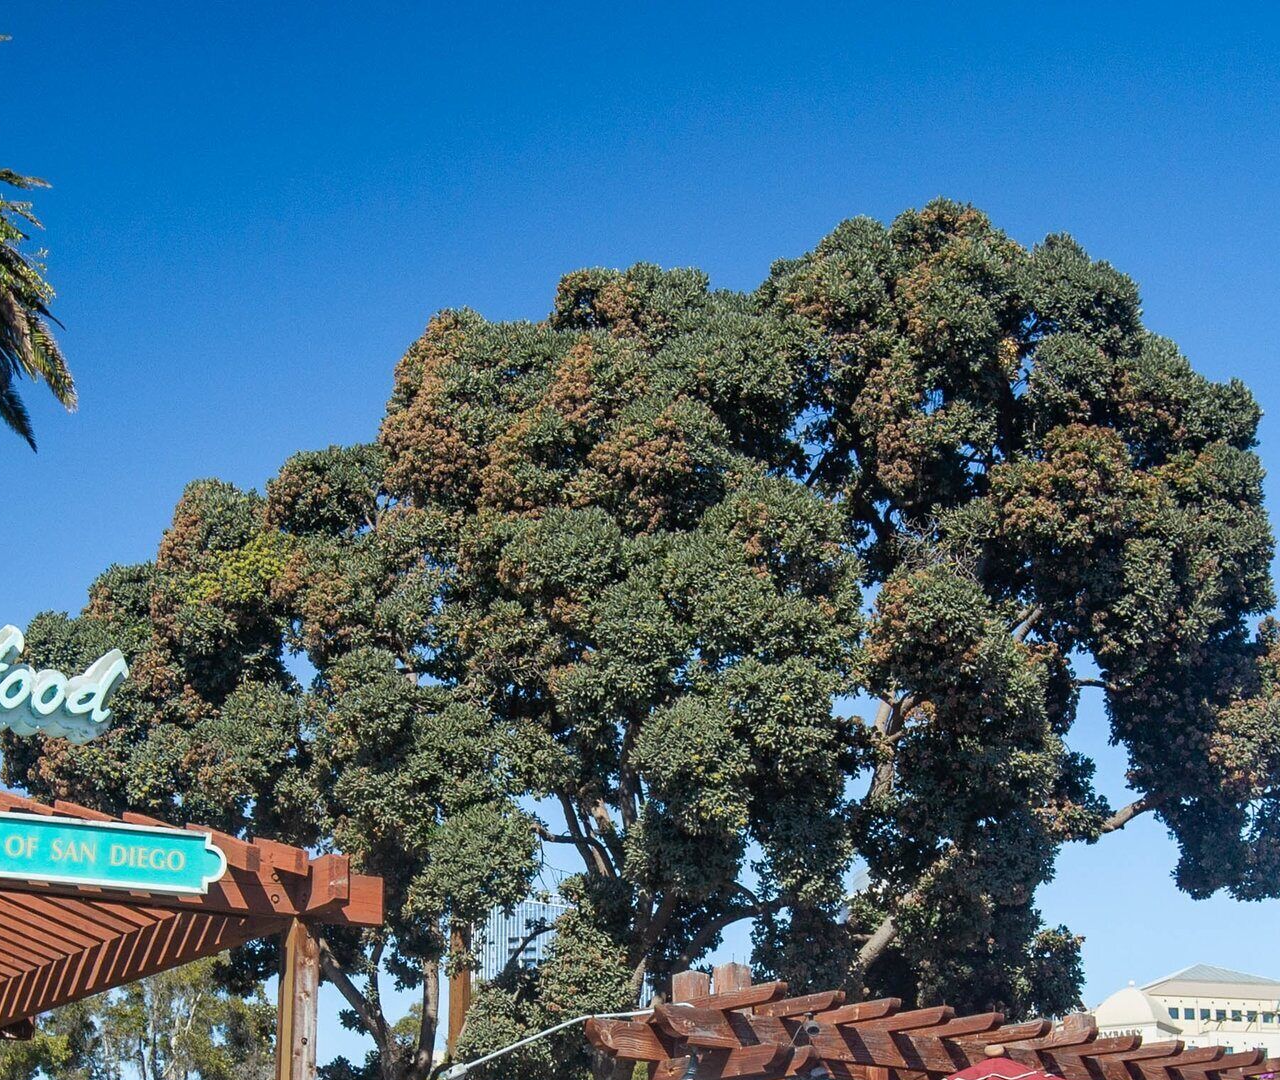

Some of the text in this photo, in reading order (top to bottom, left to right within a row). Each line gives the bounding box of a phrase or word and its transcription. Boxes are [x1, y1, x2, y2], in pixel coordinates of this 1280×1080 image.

[5, 835, 38, 859] OF
[51, 839, 96, 863] SAN
[110, 845, 185, 871] DIEGO
